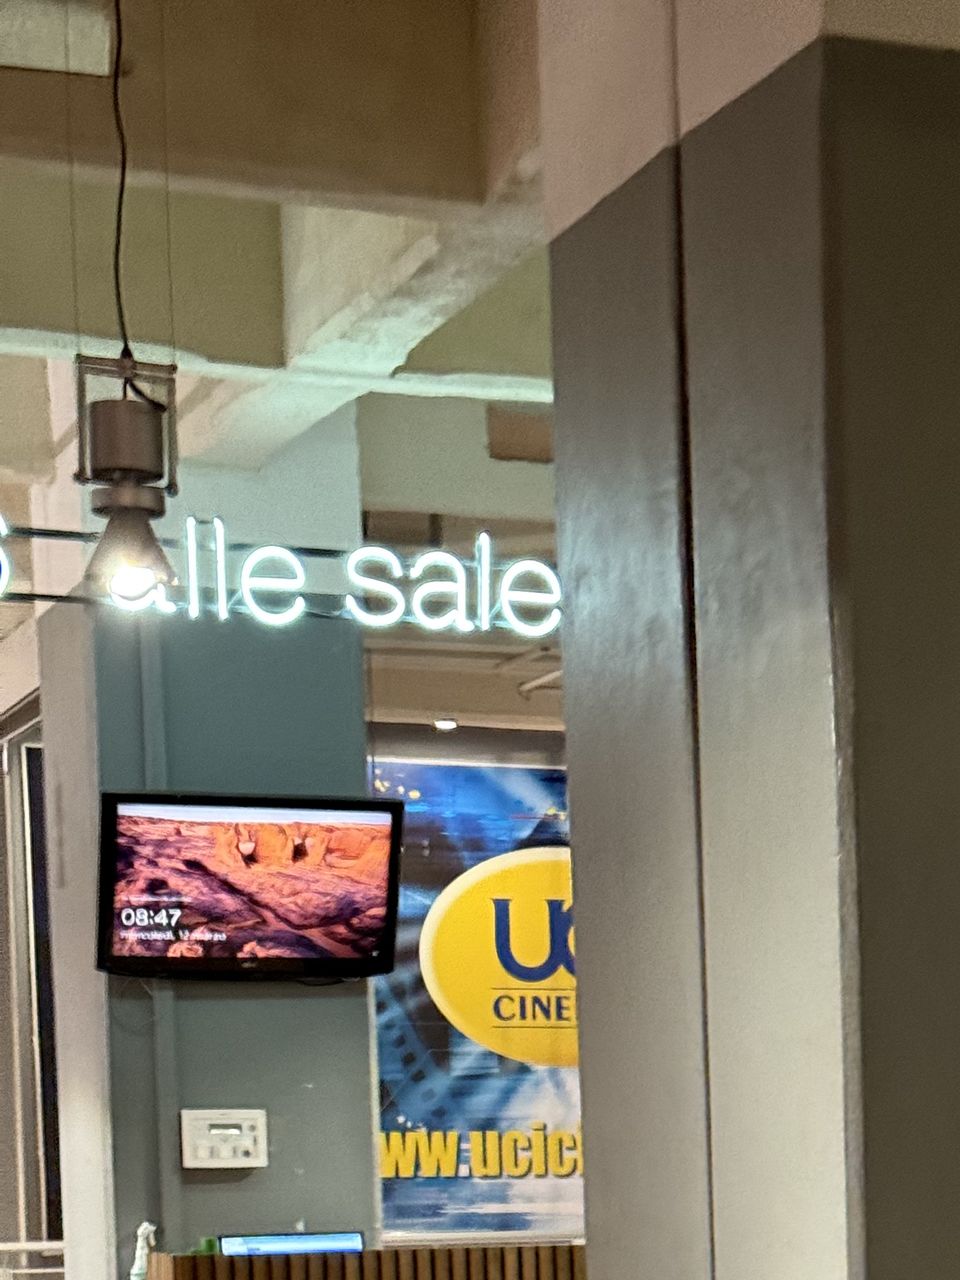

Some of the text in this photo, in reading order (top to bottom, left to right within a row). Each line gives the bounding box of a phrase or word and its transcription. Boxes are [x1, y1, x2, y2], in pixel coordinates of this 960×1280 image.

[345, 531, 562, 637] sale
[121, 907, 182, 927] 08:47
[493, 995, 572, 1021] CINE
[381, 1121, 583, 1179] ww.ucic
